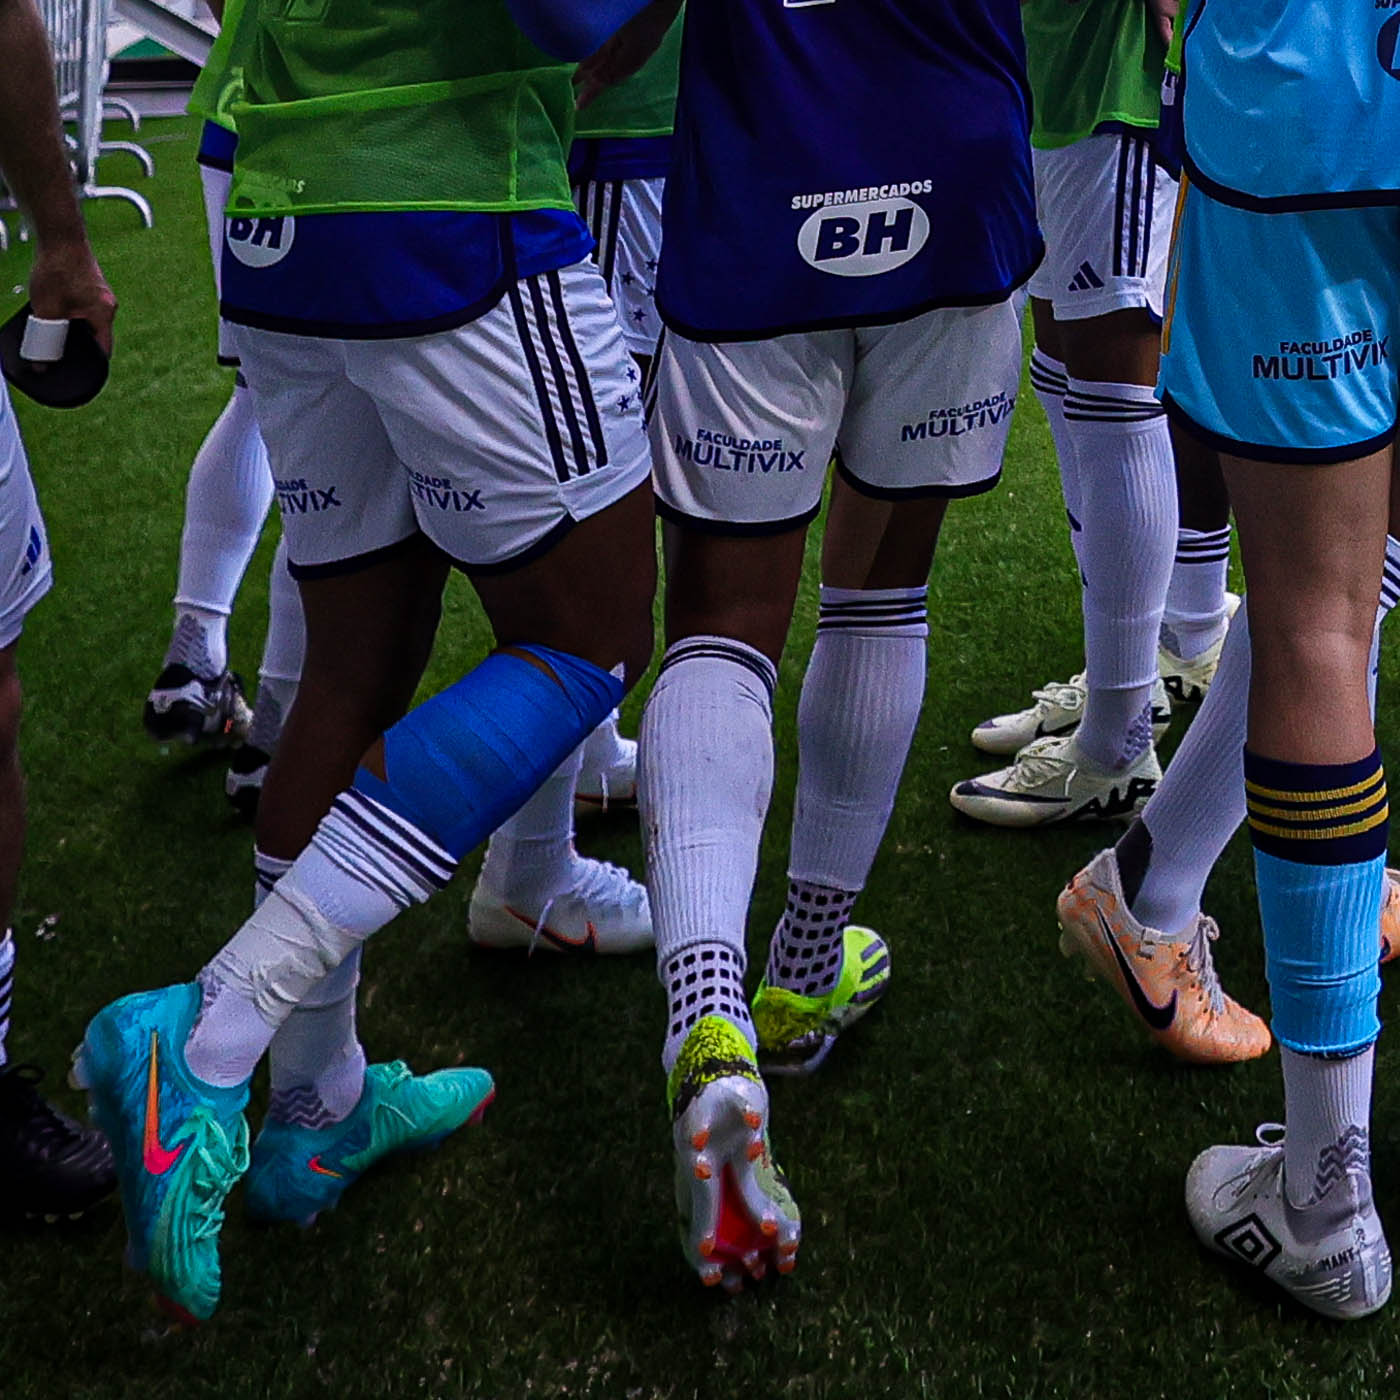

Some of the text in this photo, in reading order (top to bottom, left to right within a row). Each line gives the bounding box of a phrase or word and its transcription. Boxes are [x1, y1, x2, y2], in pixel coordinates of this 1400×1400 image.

[791, 179, 933, 210] SUPERMERCADOS
[814, 207, 915, 262] BH
[1252, 335, 1390, 380] MULTIVIX
[1280, 329, 1373, 355] FACULDADE
[901, 398, 1016, 442] MULTIVIX
[929, 391, 1008, 420] FACULDADE
[675, 435, 805, 473] MULTIVIX
[697, 428, 783, 451] FACULDADE
